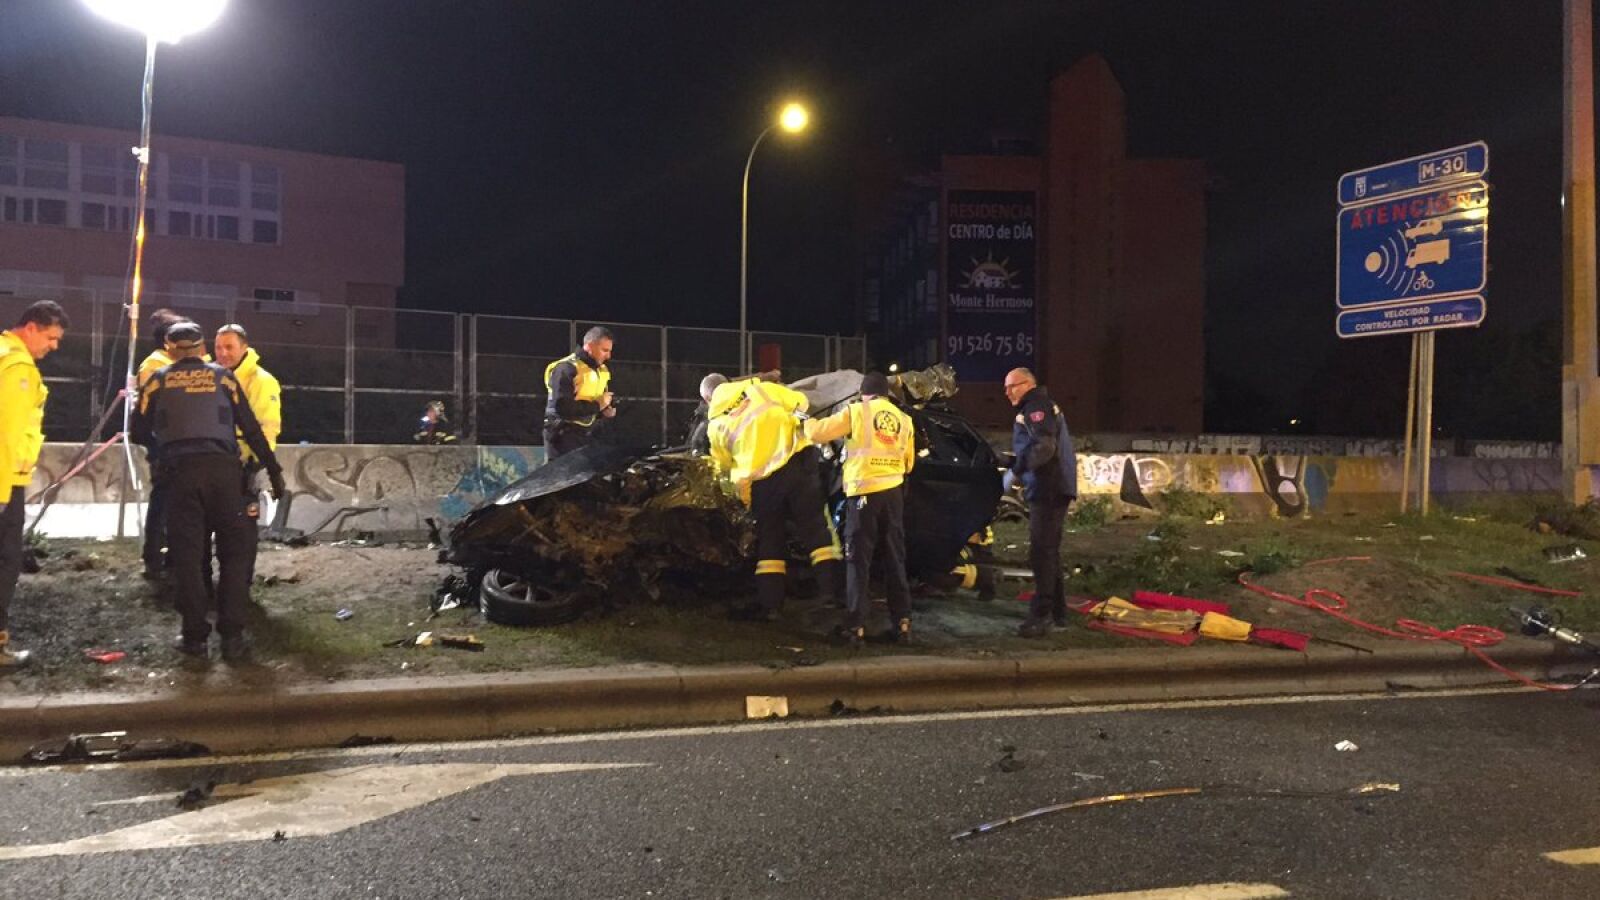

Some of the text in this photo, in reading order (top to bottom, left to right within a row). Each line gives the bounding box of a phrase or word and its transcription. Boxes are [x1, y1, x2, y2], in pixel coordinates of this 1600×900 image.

[1421, 156, 1464, 179] M-30
[949, 203, 1033, 219] RESIDENCIA
[949, 220, 1033, 239] CENTRO de DÍA
[949, 293, 1033, 308] Monte Hermoso
[1384, 306, 1430, 318] VELOCIDAD
[1355, 313, 1464, 331] CONTROLADA POR RADAR
[948, 331, 1033, 356] 91 526 75 85
